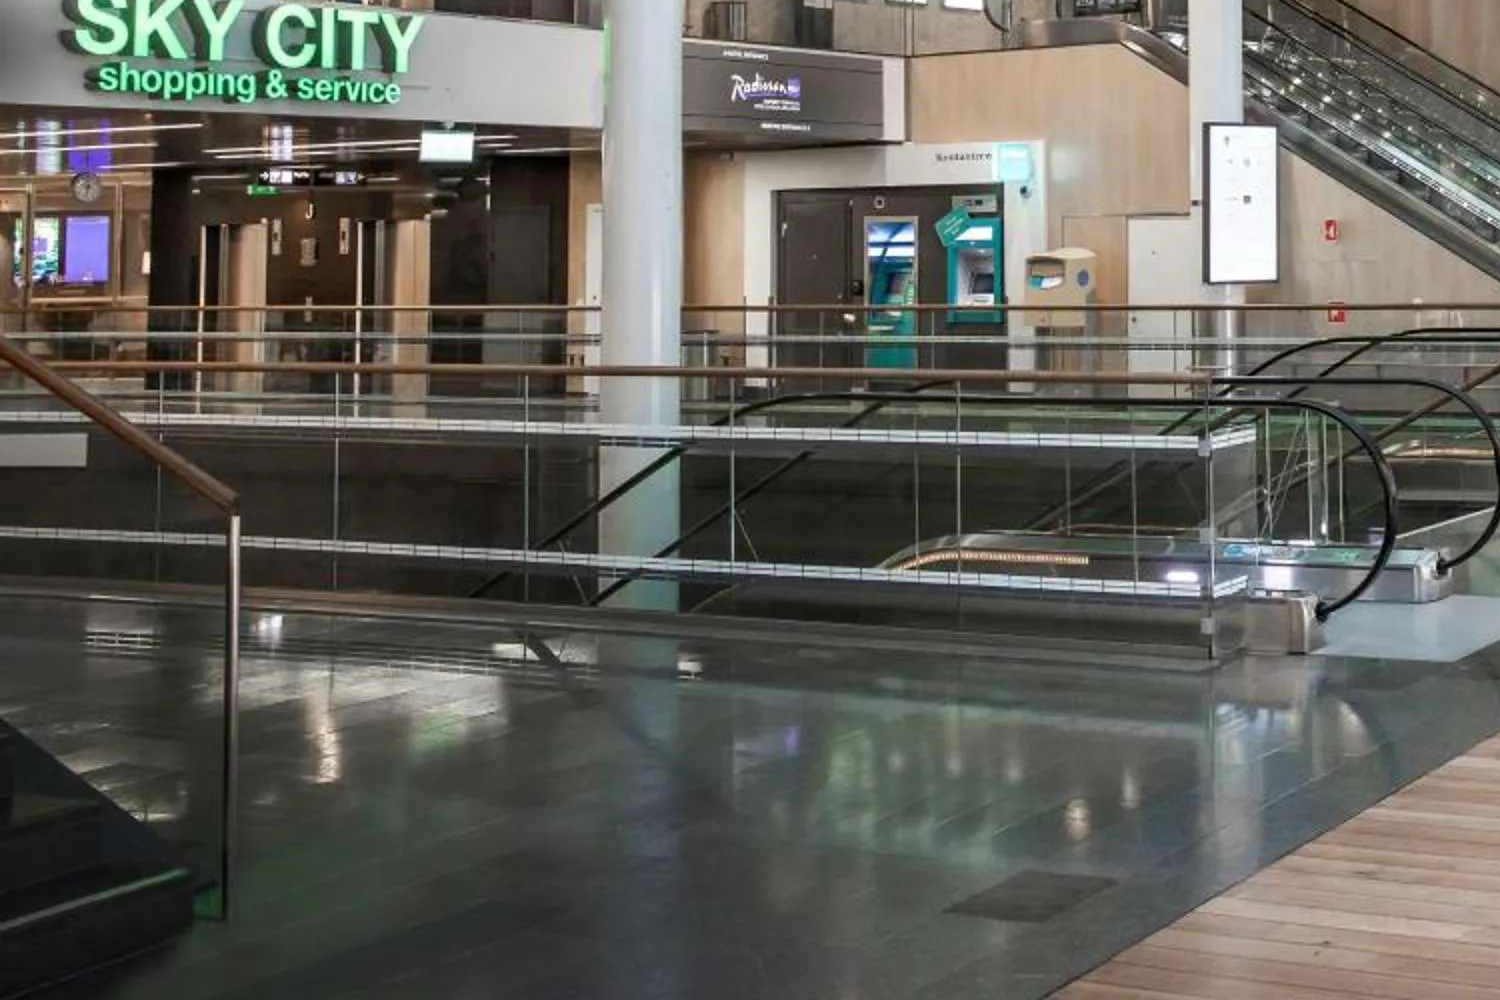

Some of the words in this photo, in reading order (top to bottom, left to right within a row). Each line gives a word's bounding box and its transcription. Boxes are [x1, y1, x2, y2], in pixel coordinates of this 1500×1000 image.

[265, 3, 426, 74] CITY
[98, 61, 258, 104] shopping
[265, 69, 290, 99] &
[296, 76, 401, 105] service
